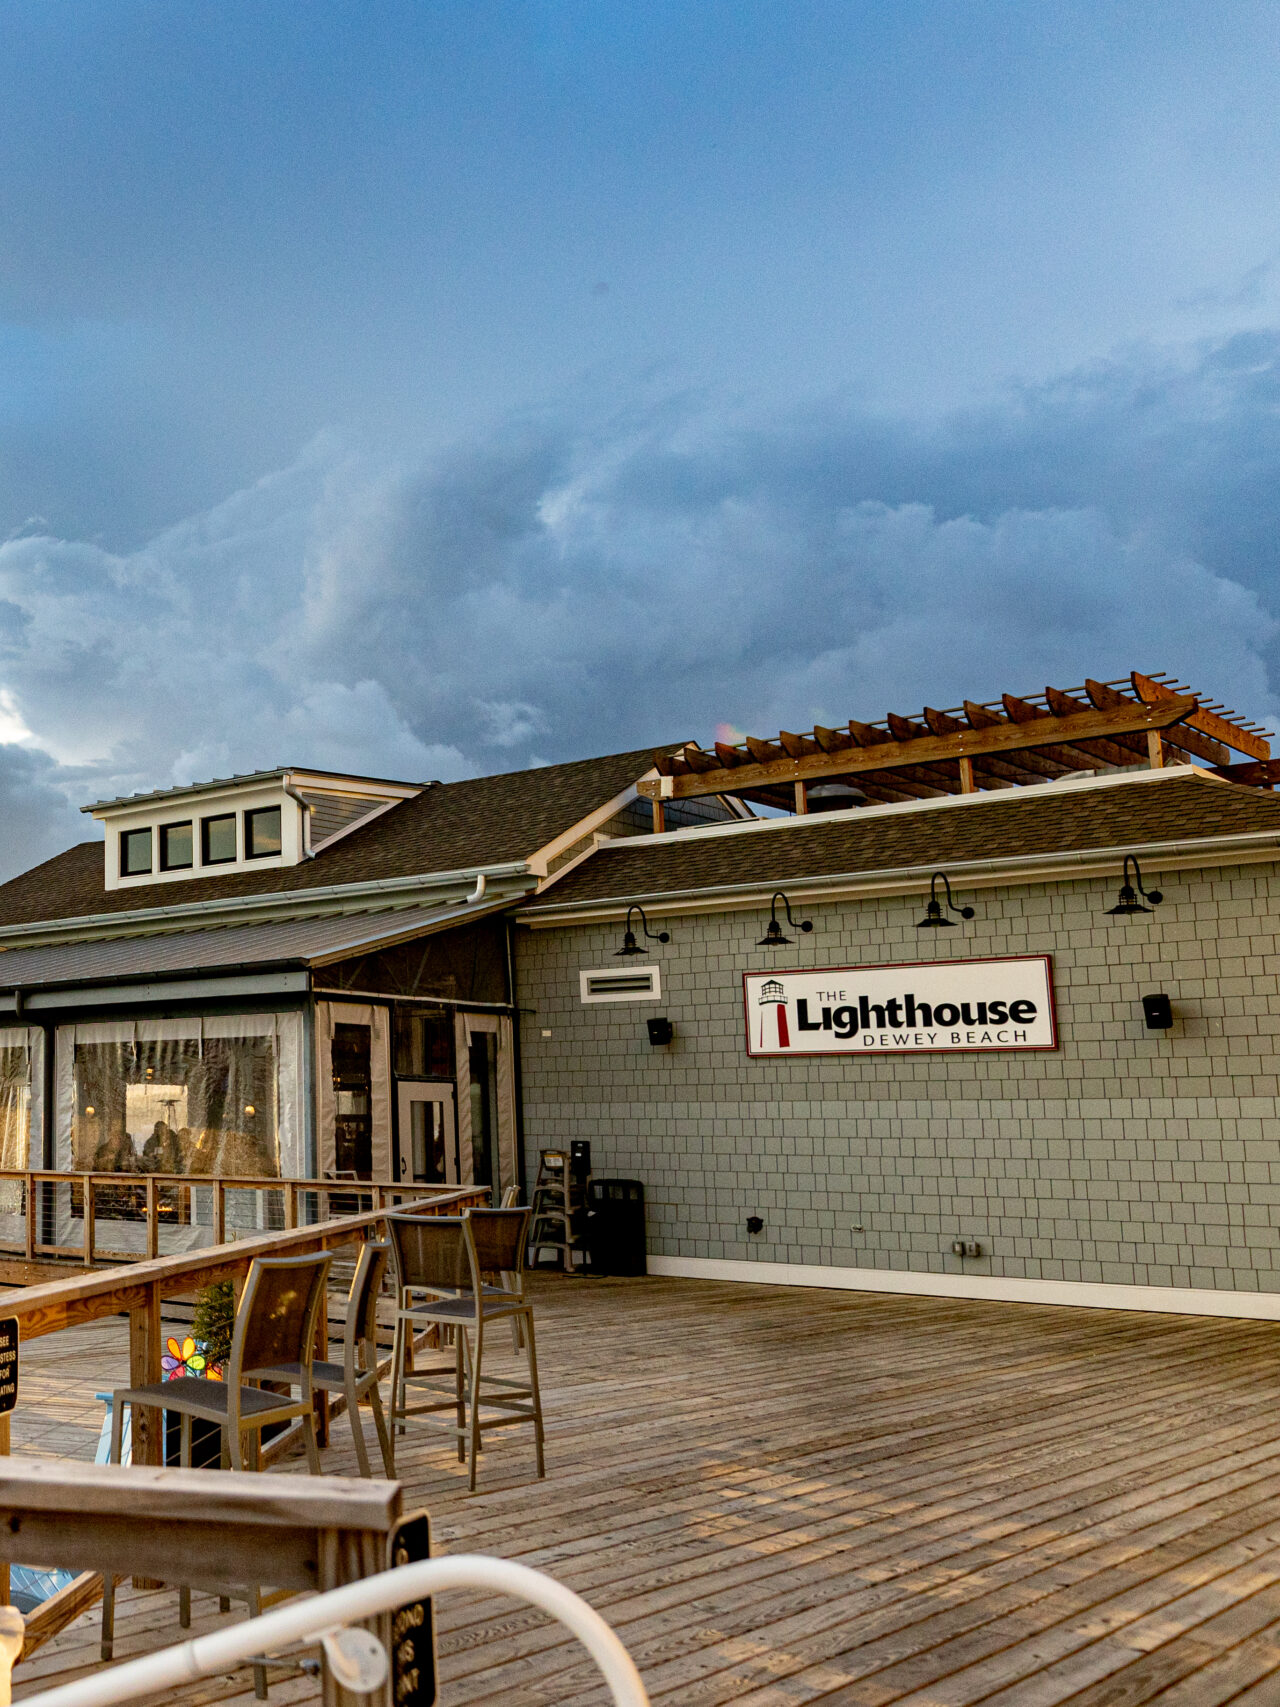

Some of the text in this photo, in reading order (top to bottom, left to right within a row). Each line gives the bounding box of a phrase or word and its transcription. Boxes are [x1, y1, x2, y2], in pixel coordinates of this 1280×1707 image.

[816, 991, 847, 1002] THE
[797, 994, 1037, 1039] Lighthouse
[863, 1029, 1028, 1047] DEWEY BEACH
[0, 1335, 9, 1347] SEE
